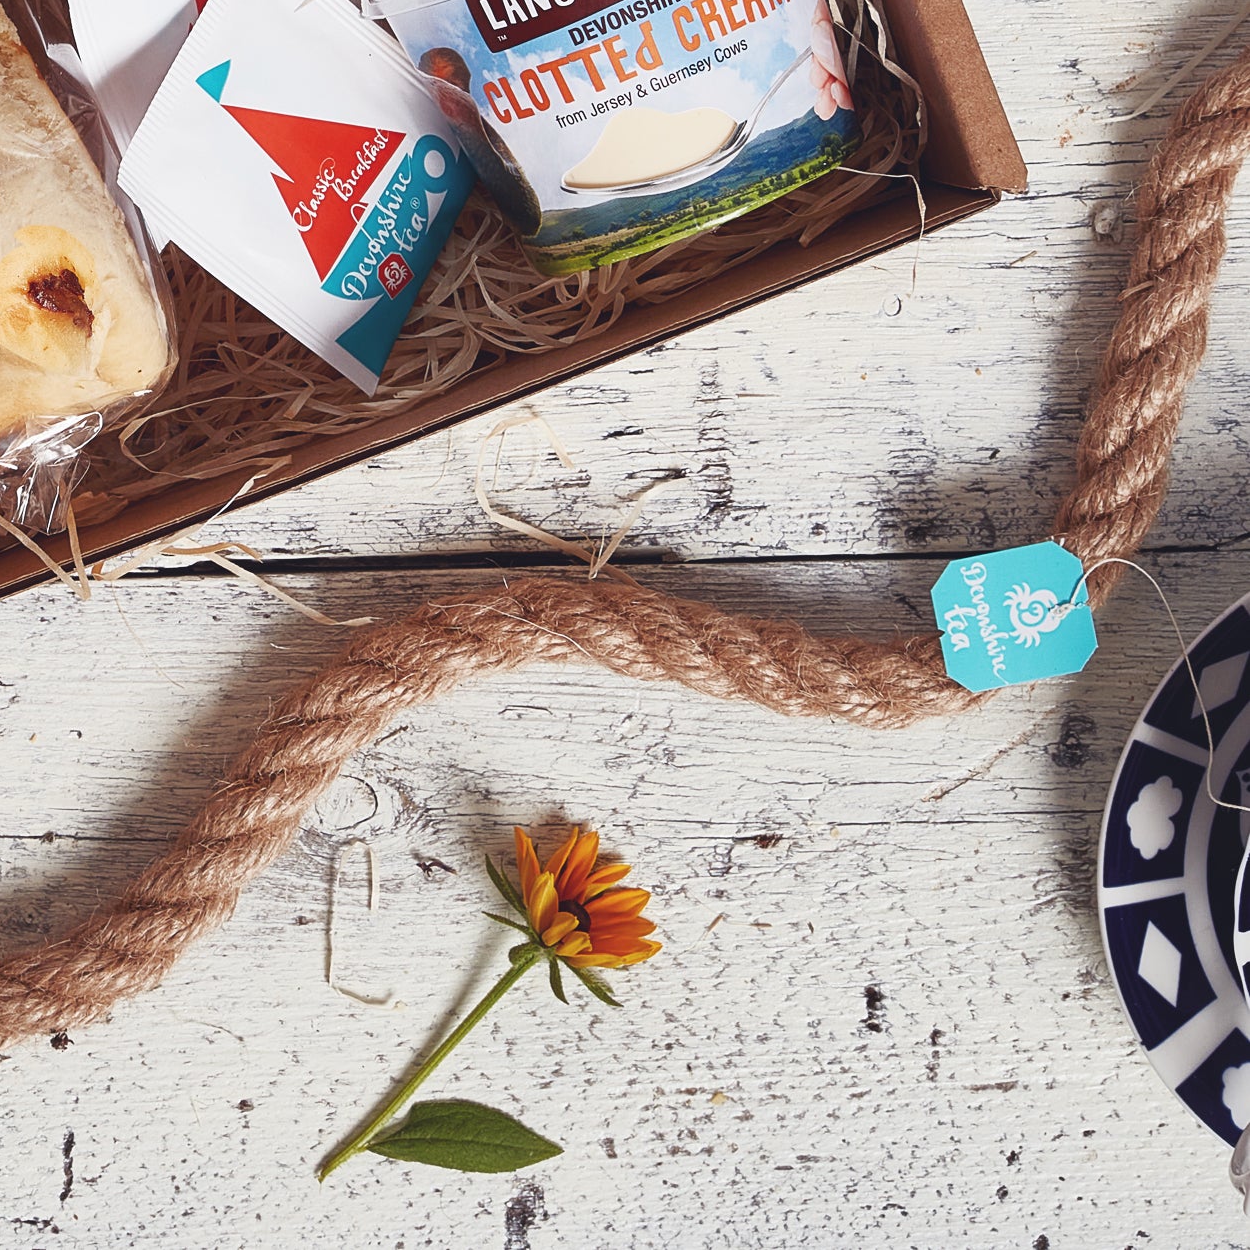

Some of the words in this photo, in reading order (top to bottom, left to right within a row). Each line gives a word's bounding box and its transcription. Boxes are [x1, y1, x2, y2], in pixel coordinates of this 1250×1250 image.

[555, 108, 588, 129] from
[590, 91, 633, 118] Jersey
[635, 82, 649, 99] &
[650, 55, 712, 93] Guernsey
[715, 38, 749, 64] Cows
[292, 157, 336, 232] Classic
[332, 128, 389, 201] Breakfast
[341, 156, 412, 300] Devonshire
[944, 604, 977, 652] tea
[960, 562, 1009, 685] Devonshire
